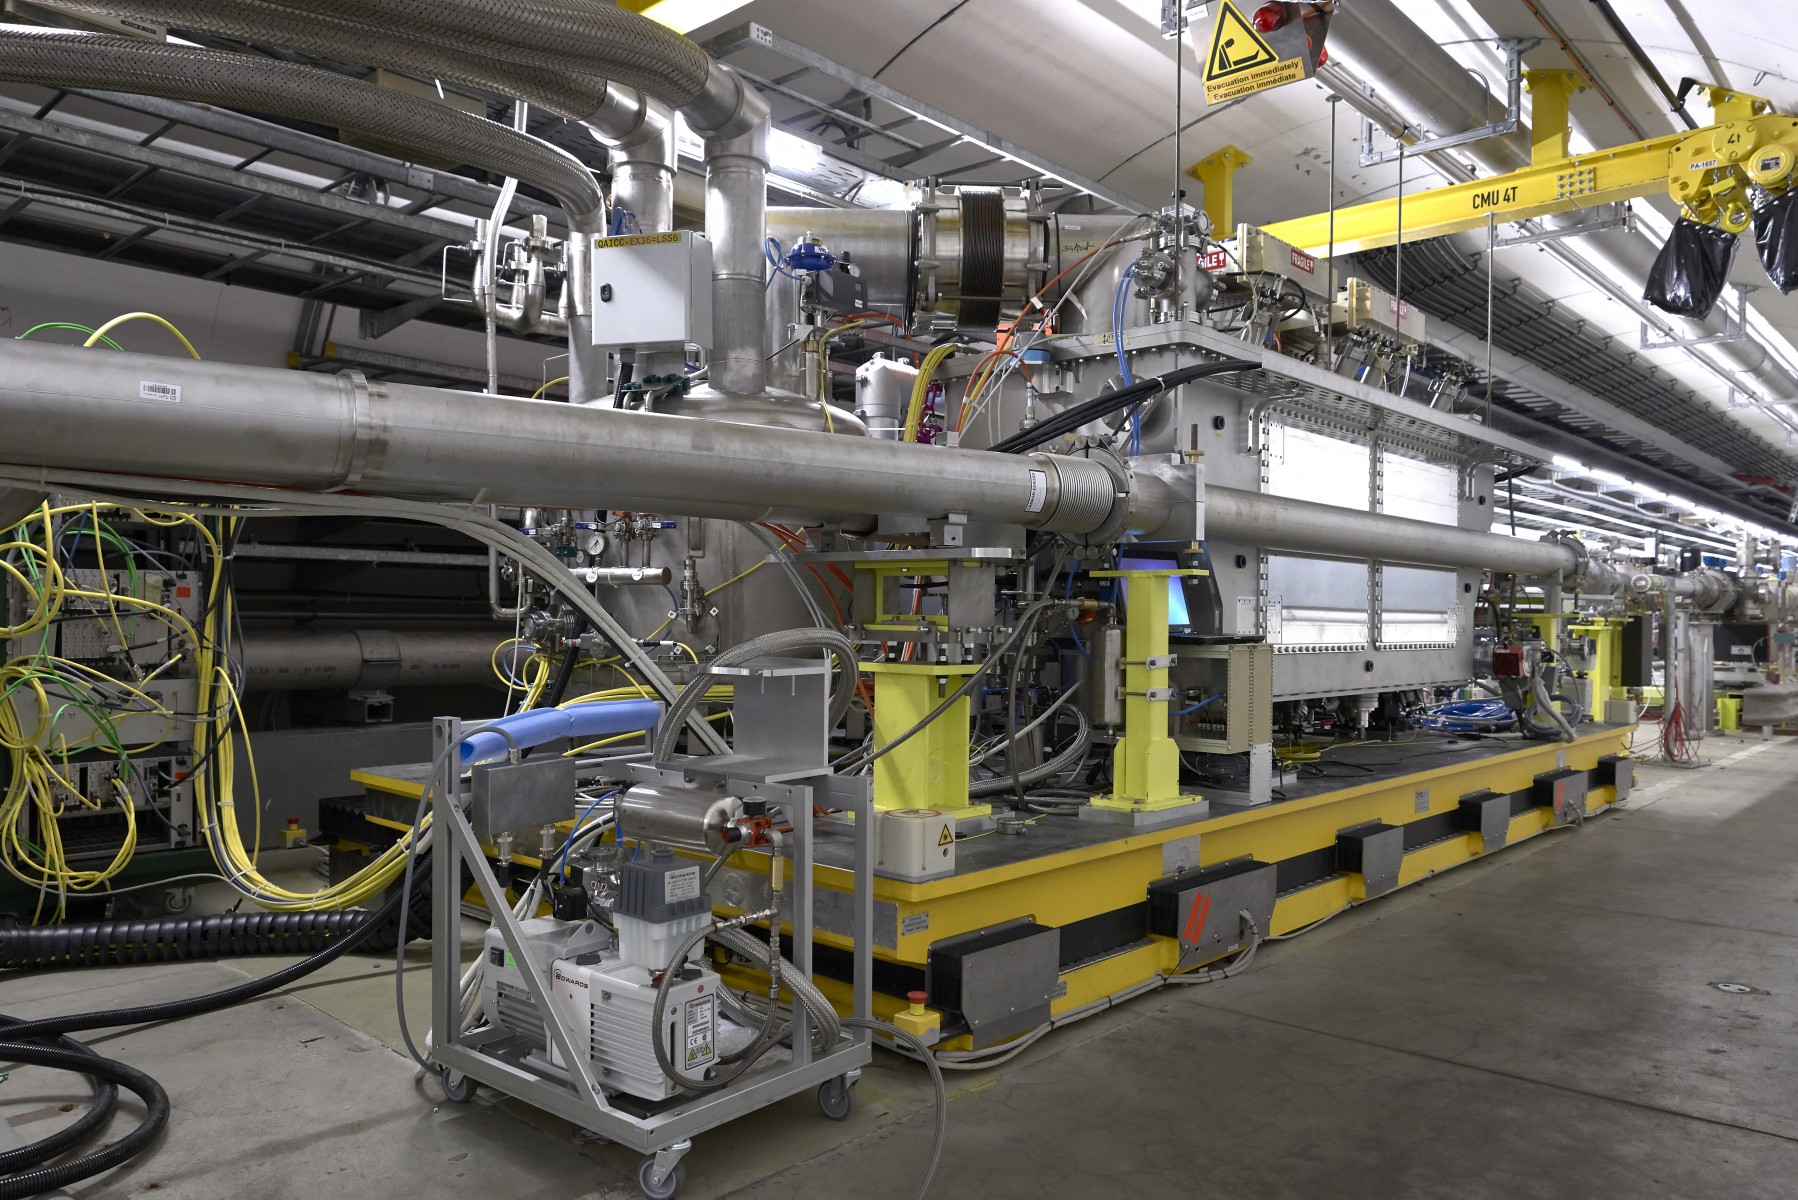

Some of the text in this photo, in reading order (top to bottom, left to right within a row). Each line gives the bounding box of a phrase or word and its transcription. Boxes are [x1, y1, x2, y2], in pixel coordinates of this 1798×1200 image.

[1207, 61, 1299, 92] Evacuation immediately
[1213, 73, 1297, 101] Evacuation immédiate
[1690, 160, 1716, 170] PA-1657
[1473, 186, 1518, 209] CMU 4T
[598, 234, 679, 248] QAICC-EX36=LSS6
[1291, 251, 1310, 271] FRAGILE
[555, 970, 588, 989] EDWARDS
